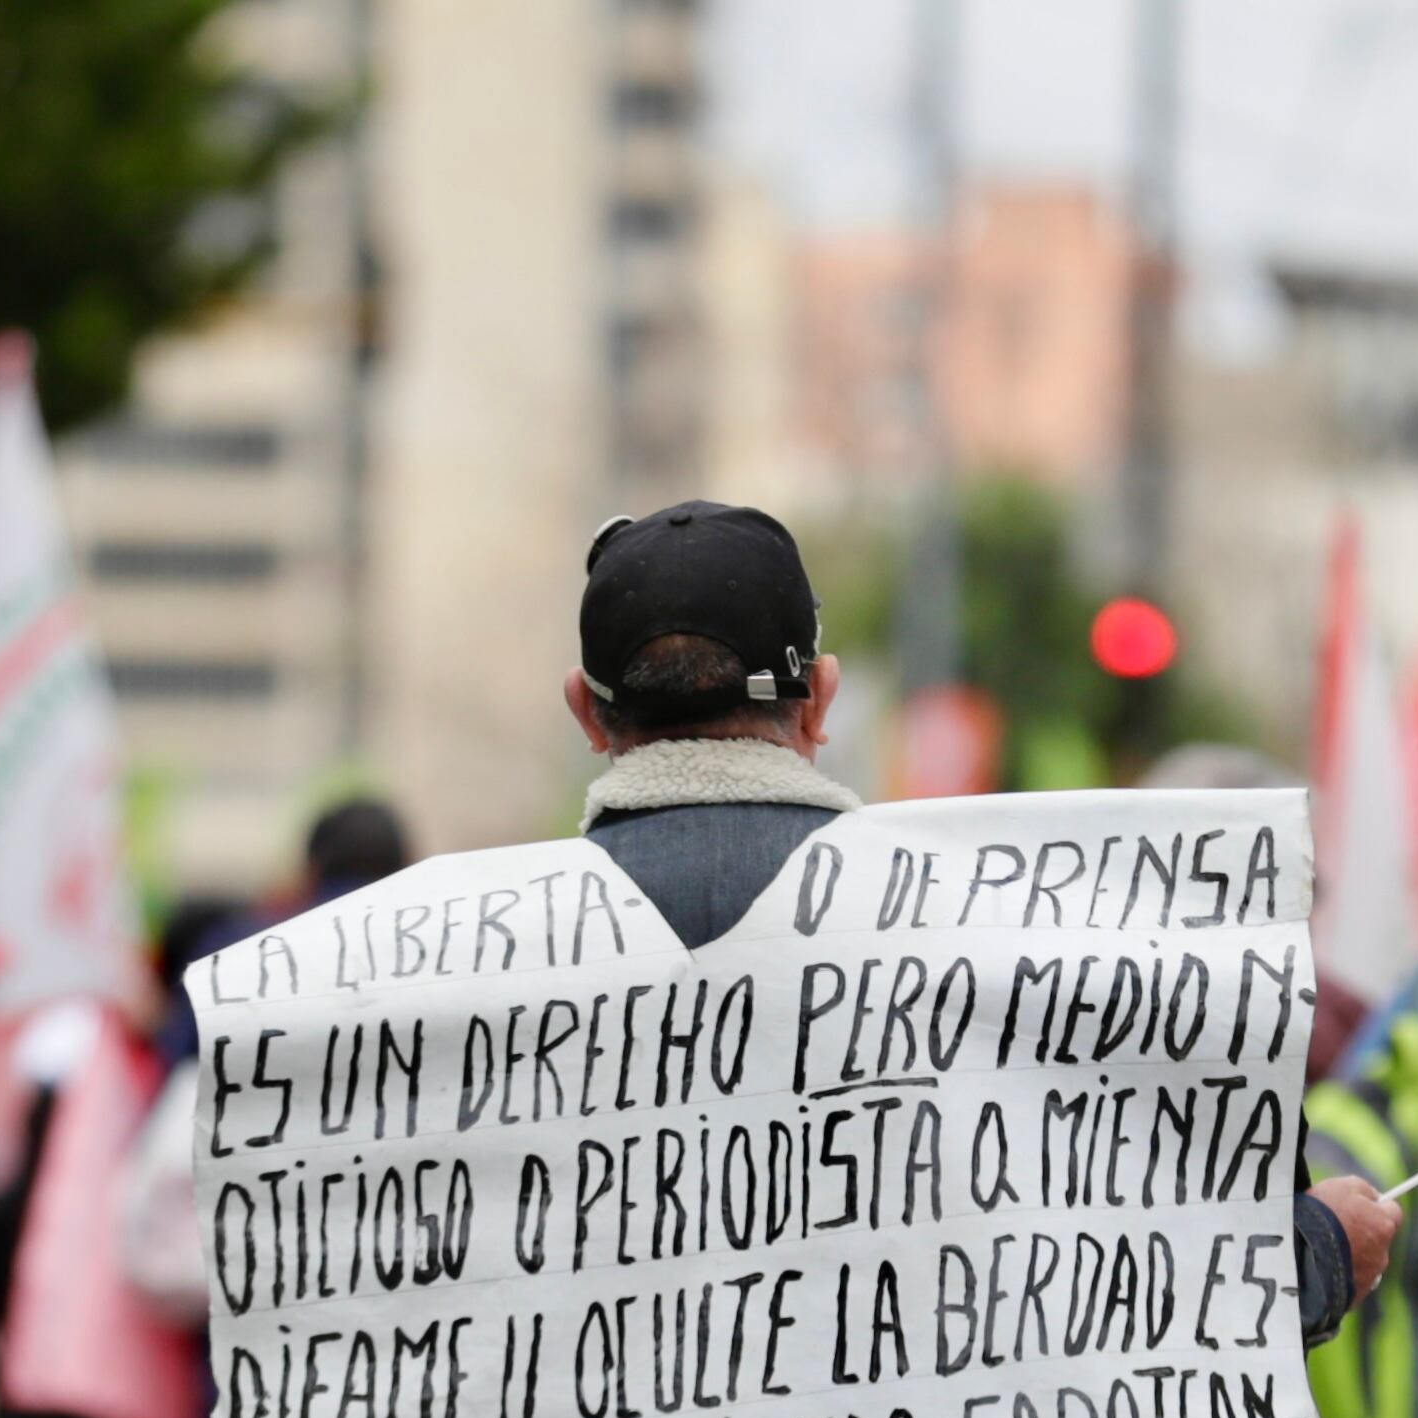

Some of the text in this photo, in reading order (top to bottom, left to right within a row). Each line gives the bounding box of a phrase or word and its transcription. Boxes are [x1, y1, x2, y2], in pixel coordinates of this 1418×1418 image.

[211, 935, 298, 1003] LA
[876, 847, 940, 931] DE
[957, 826, 1280, 930] PRENSA
[210, 1029, 293, 1157] ES
[320, 1018, 423, 1139] UN
[457, 974, 754, 1132] DERECHO
[793, 956, 976, 1094] PERO
[515, 1154, 553, 1273] O
[970, 1101, 1020, 1212] Q
[831, 1260, 910, 1383] LA
[934, 1231, 1175, 1376] BERDAD
